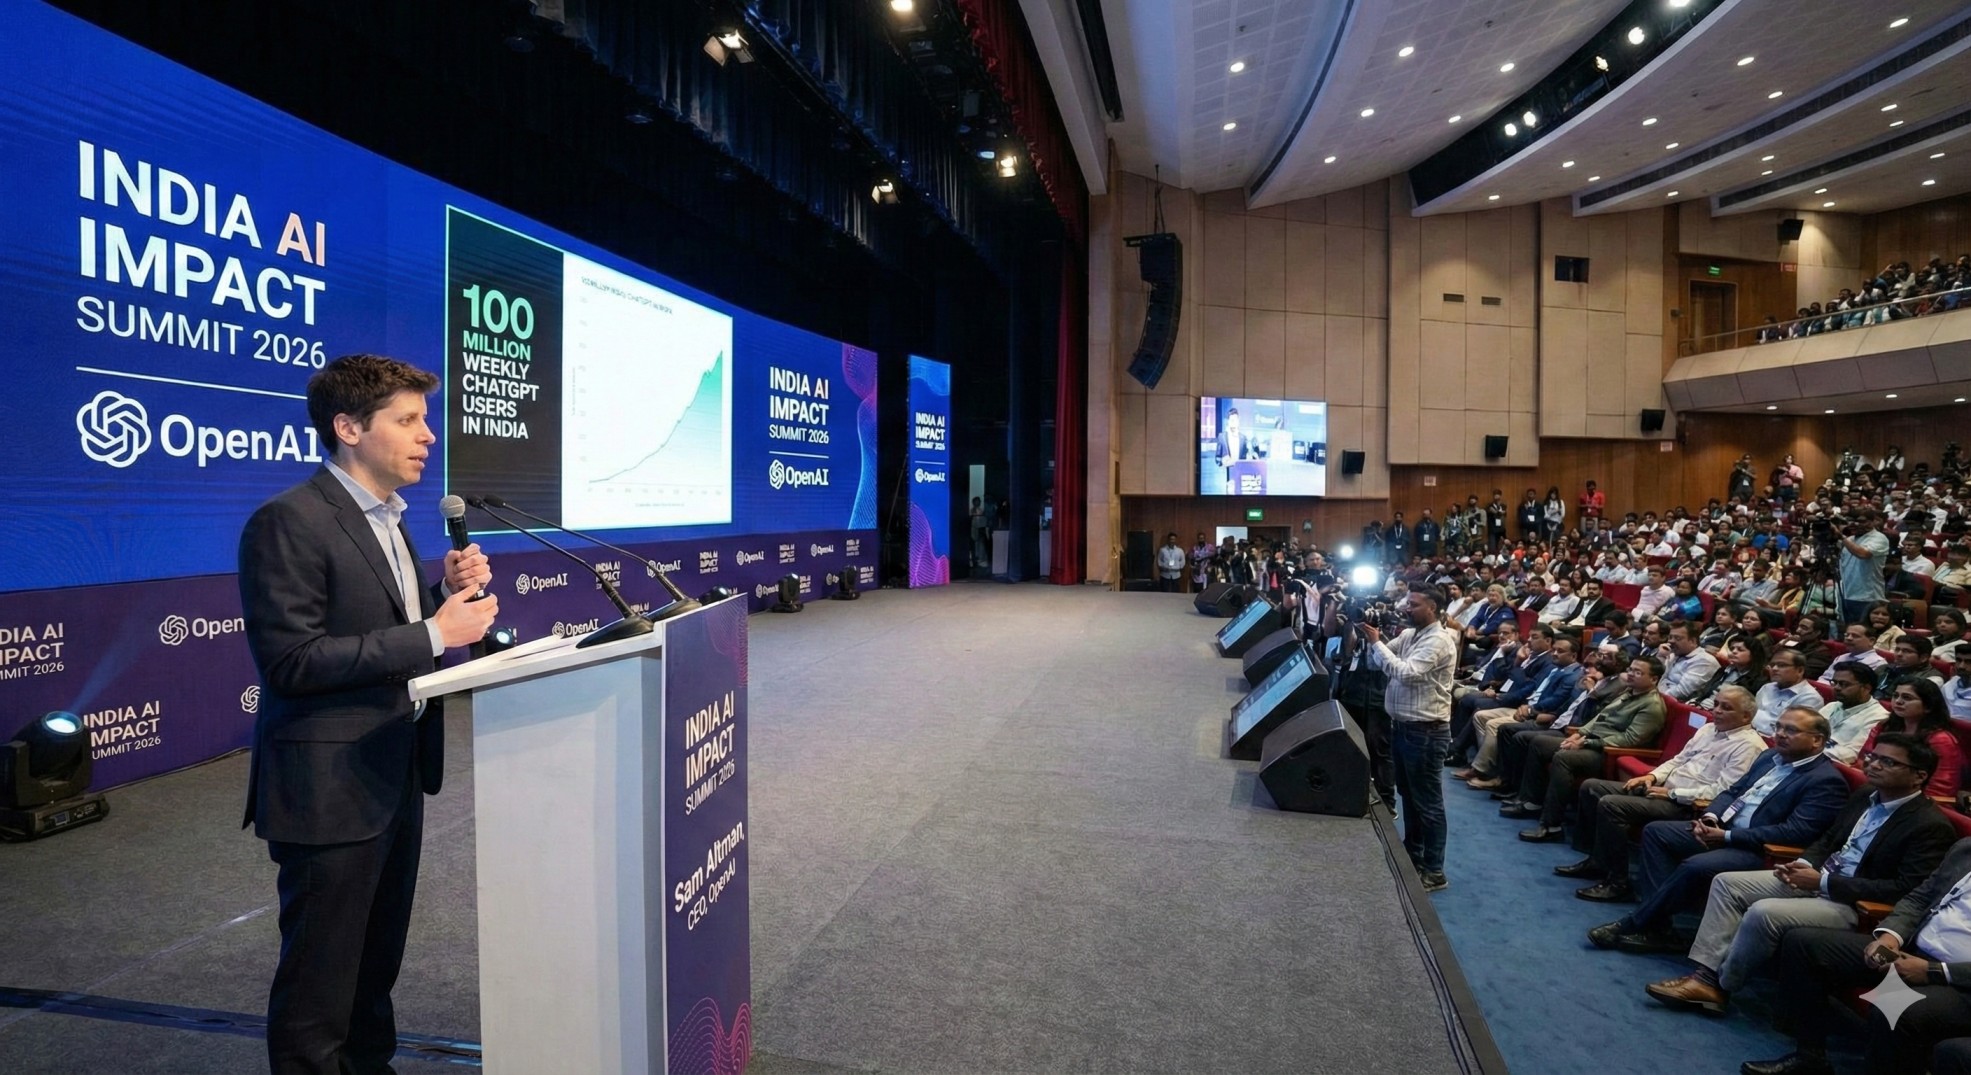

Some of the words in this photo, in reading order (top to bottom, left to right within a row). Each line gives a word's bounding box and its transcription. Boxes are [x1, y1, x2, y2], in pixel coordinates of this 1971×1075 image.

[79, 140, 262, 249] INDIA
[276, 212, 325, 267] AI
[80, 216, 326, 326] IMPACT
[463, 284, 535, 340] 100
[76, 296, 243, 355] SUMMIT
[253, 330, 326, 369] 2026
[463, 330, 531, 361] MILLION
[462, 352, 530, 380] WEEKLY
[462, 374, 540, 402] CHATGPT
[770, 366, 811, 397] INDIA
[814, 377, 829, 400] AI
[462, 394, 518, 418] USERS
[770, 395, 829, 426] IMPACT
[160, 414, 323, 467] OpenAI
[463, 416, 480, 435] IN
[485, 418, 529, 439] INDIA
[769, 424, 807, 442] SUMMIT
[808, 429, 829, 444] 2026
[785, 466, 829, 488] OpenAI
[531, 573, 568, 592] OpenAI
[42, 622, 64, 640] AI
[192, 617, 245, 640] Open
[566, 618, 599, 637] OpenAI
[33, 661, 65, 675] 2026
[83, 705, 138, 728] INDIA
[141, 700, 160, 718] AI
[686, 700, 720, 750] INDIA
[722, 690, 734, 723] AI
[90, 718, 160, 747] MPACT
[92, 742, 132, 760] UMMIT
[134, 736, 161, 750] 2026
[686, 723, 735, 789] IMPACT
[685, 772, 718, 816] SUMMIT
[674, 866, 704, 913] Sam
[706, 821, 745, 879] Altman,
[687, 895, 708, 931] CEO,
